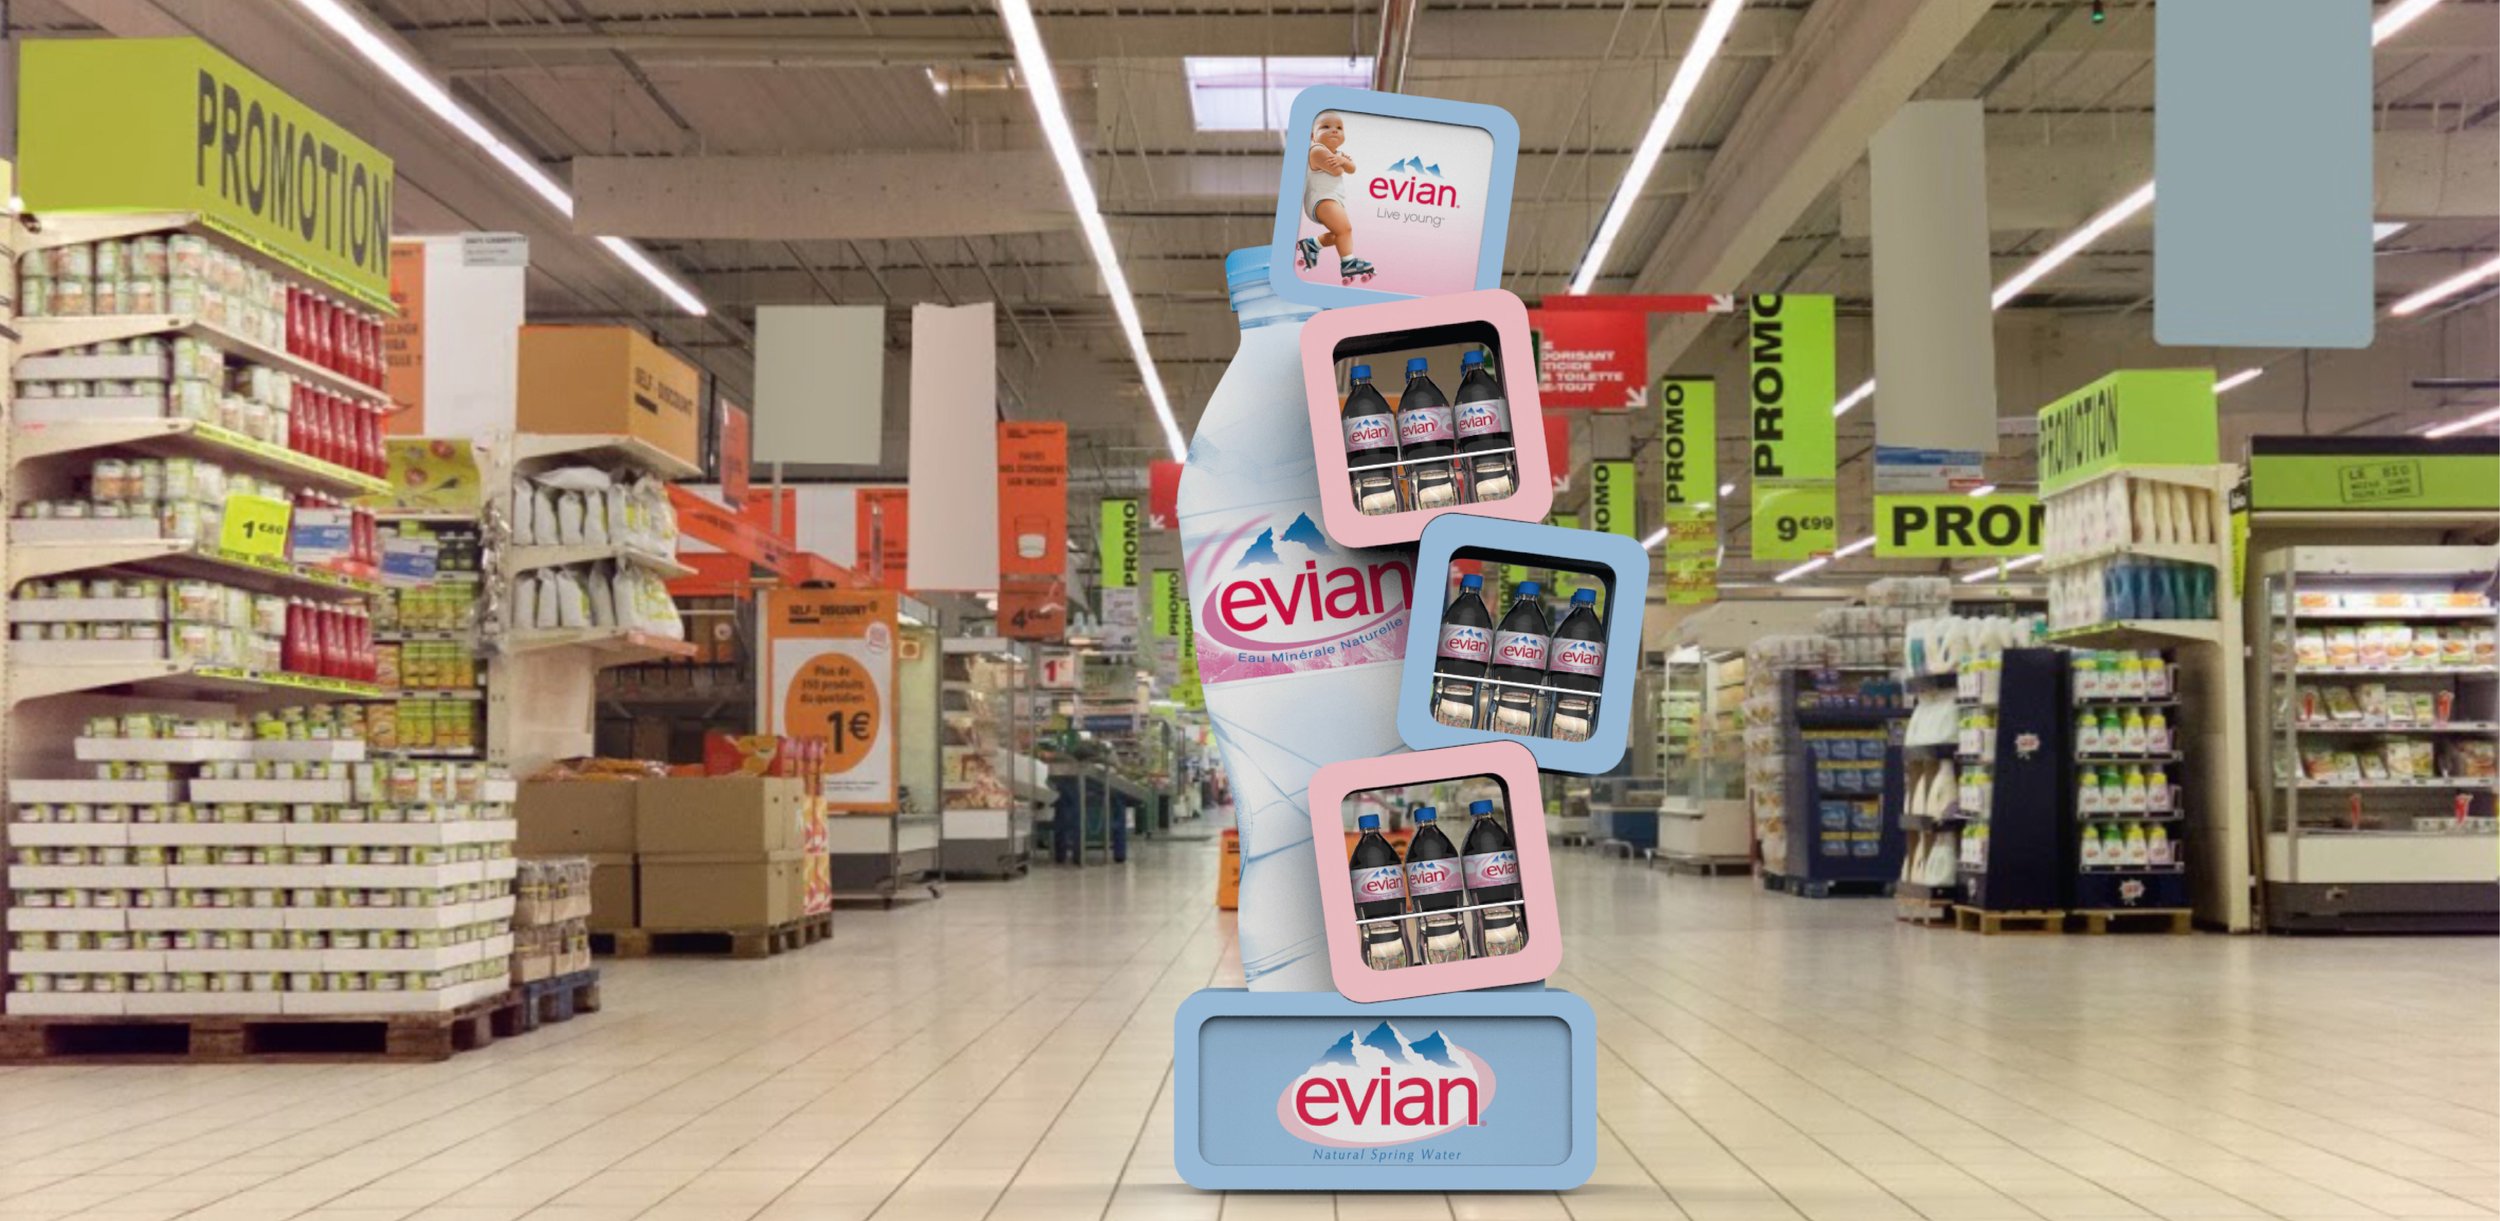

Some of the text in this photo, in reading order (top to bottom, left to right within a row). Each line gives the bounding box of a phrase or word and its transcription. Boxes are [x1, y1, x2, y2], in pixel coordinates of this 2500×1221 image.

[198, 69, 388, 278] PROMOTION
[1377, 208, 1442, 228] Live young
[1541, 350, 1615, 361] DORISANT
[1543, 362, 1592, 370] TICIDE
[1401, 420, 1435, 437] evian
[1459, 414, 1493, 431] evian
[2041, 384, 2118, 478] PROMOTION
[1352, 427, 1388, 442] evian
[1664, 384, 1685, 503] PROMO
[1123, 503, 1138, 586] PROMO
[1168, 572, 1180, 636] PROMO
[1221, 560, 1414, 631] evian
[820, 604, 867, 616] DISCOUNT
[1238, 617, 1403, 663] Eau Minérale Naturelle
[1449, 637, 1487, 653] evian
[1504, 645, 1543, 660] evian
[1562, 651, 1600, 666] evian
[827, 711, 870, 753] 1€
[1409, 869, 1445, 885] evian
[1295, 1067, 1479, 1126] evian
[1312, 1149, 1462, 1163] Natural Spring Water
